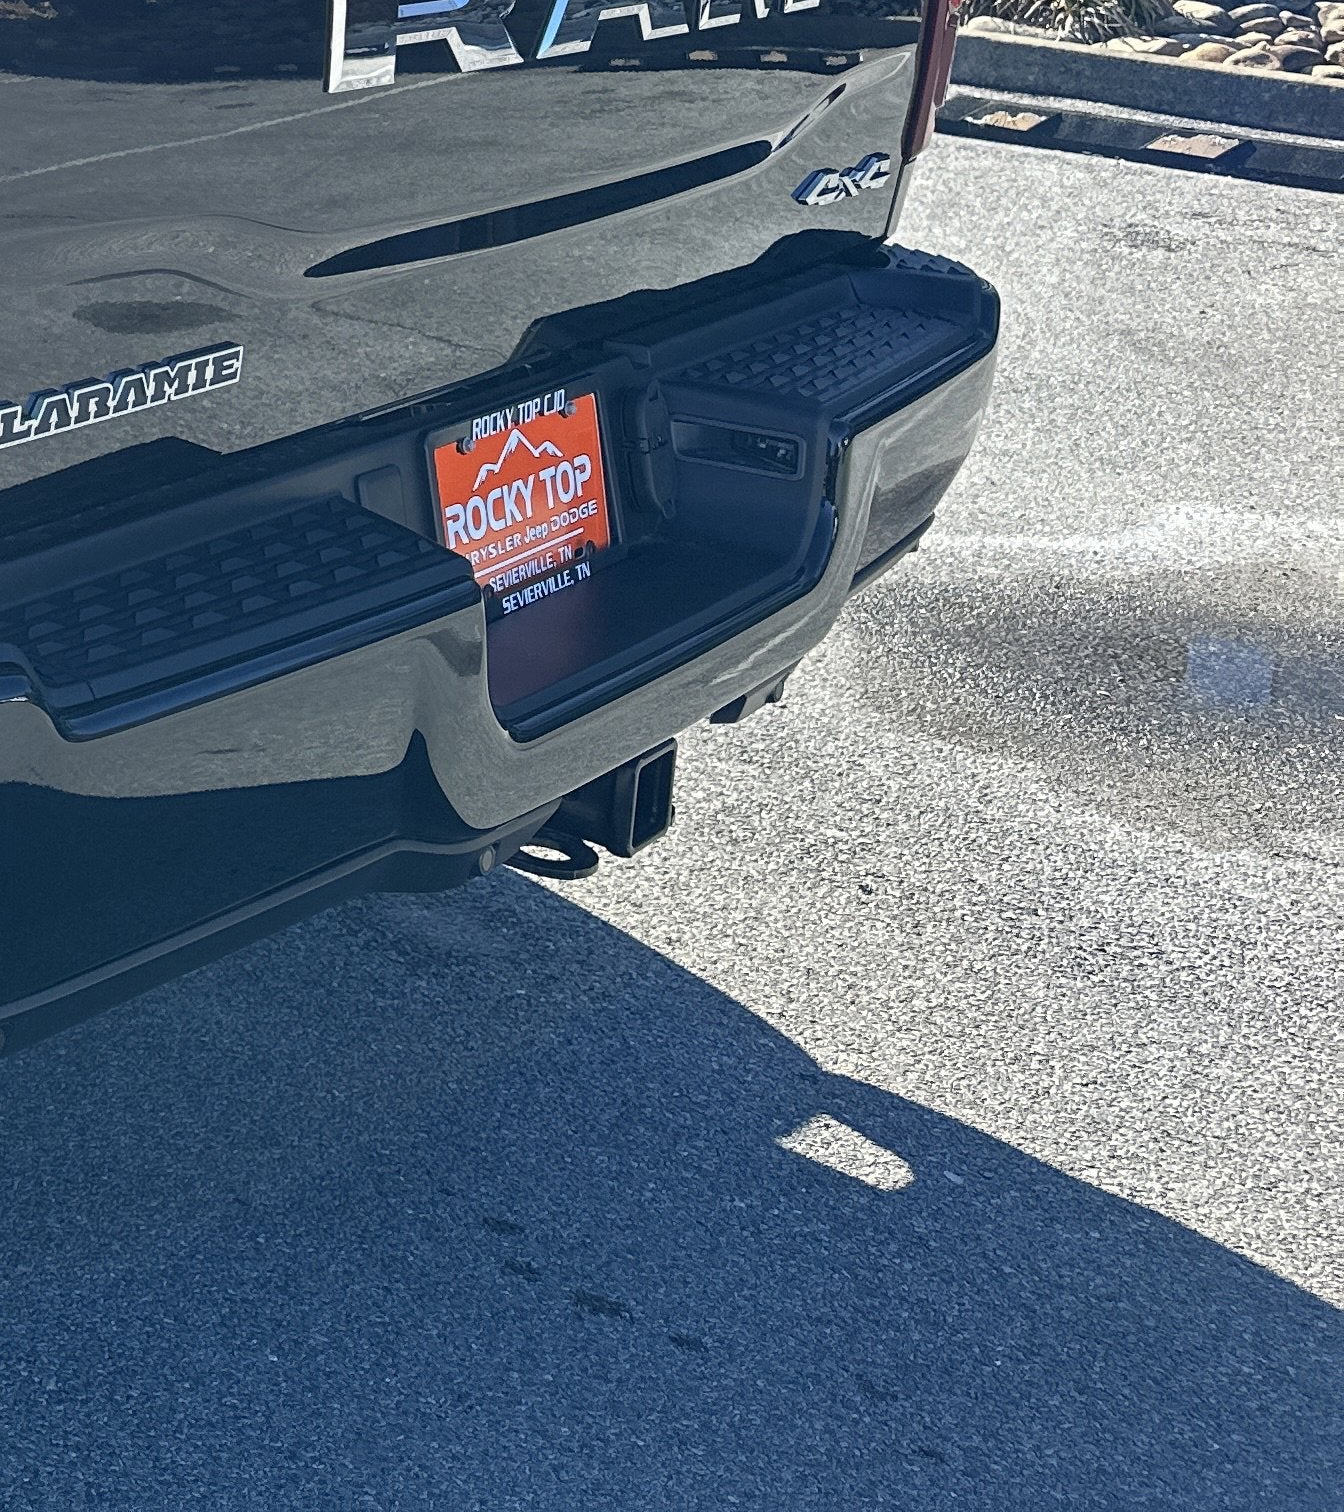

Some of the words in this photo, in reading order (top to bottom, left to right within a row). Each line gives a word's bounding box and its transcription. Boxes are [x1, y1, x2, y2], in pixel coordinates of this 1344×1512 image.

[472, 406, 514, 441] ROCKY
[518, 397, 541, 426] TOP
[445, 474, 535, 549] ROCKY
[539, 454, 591, 509] TOP
[524, 522, 549, 544] Jeep
[551, 499, 598, 532] DODGE
[558, 543, 573, 564] TN
[502, 569, 575, 615] SEVIERVILLE,
[575, 560, 592, 582] TN
